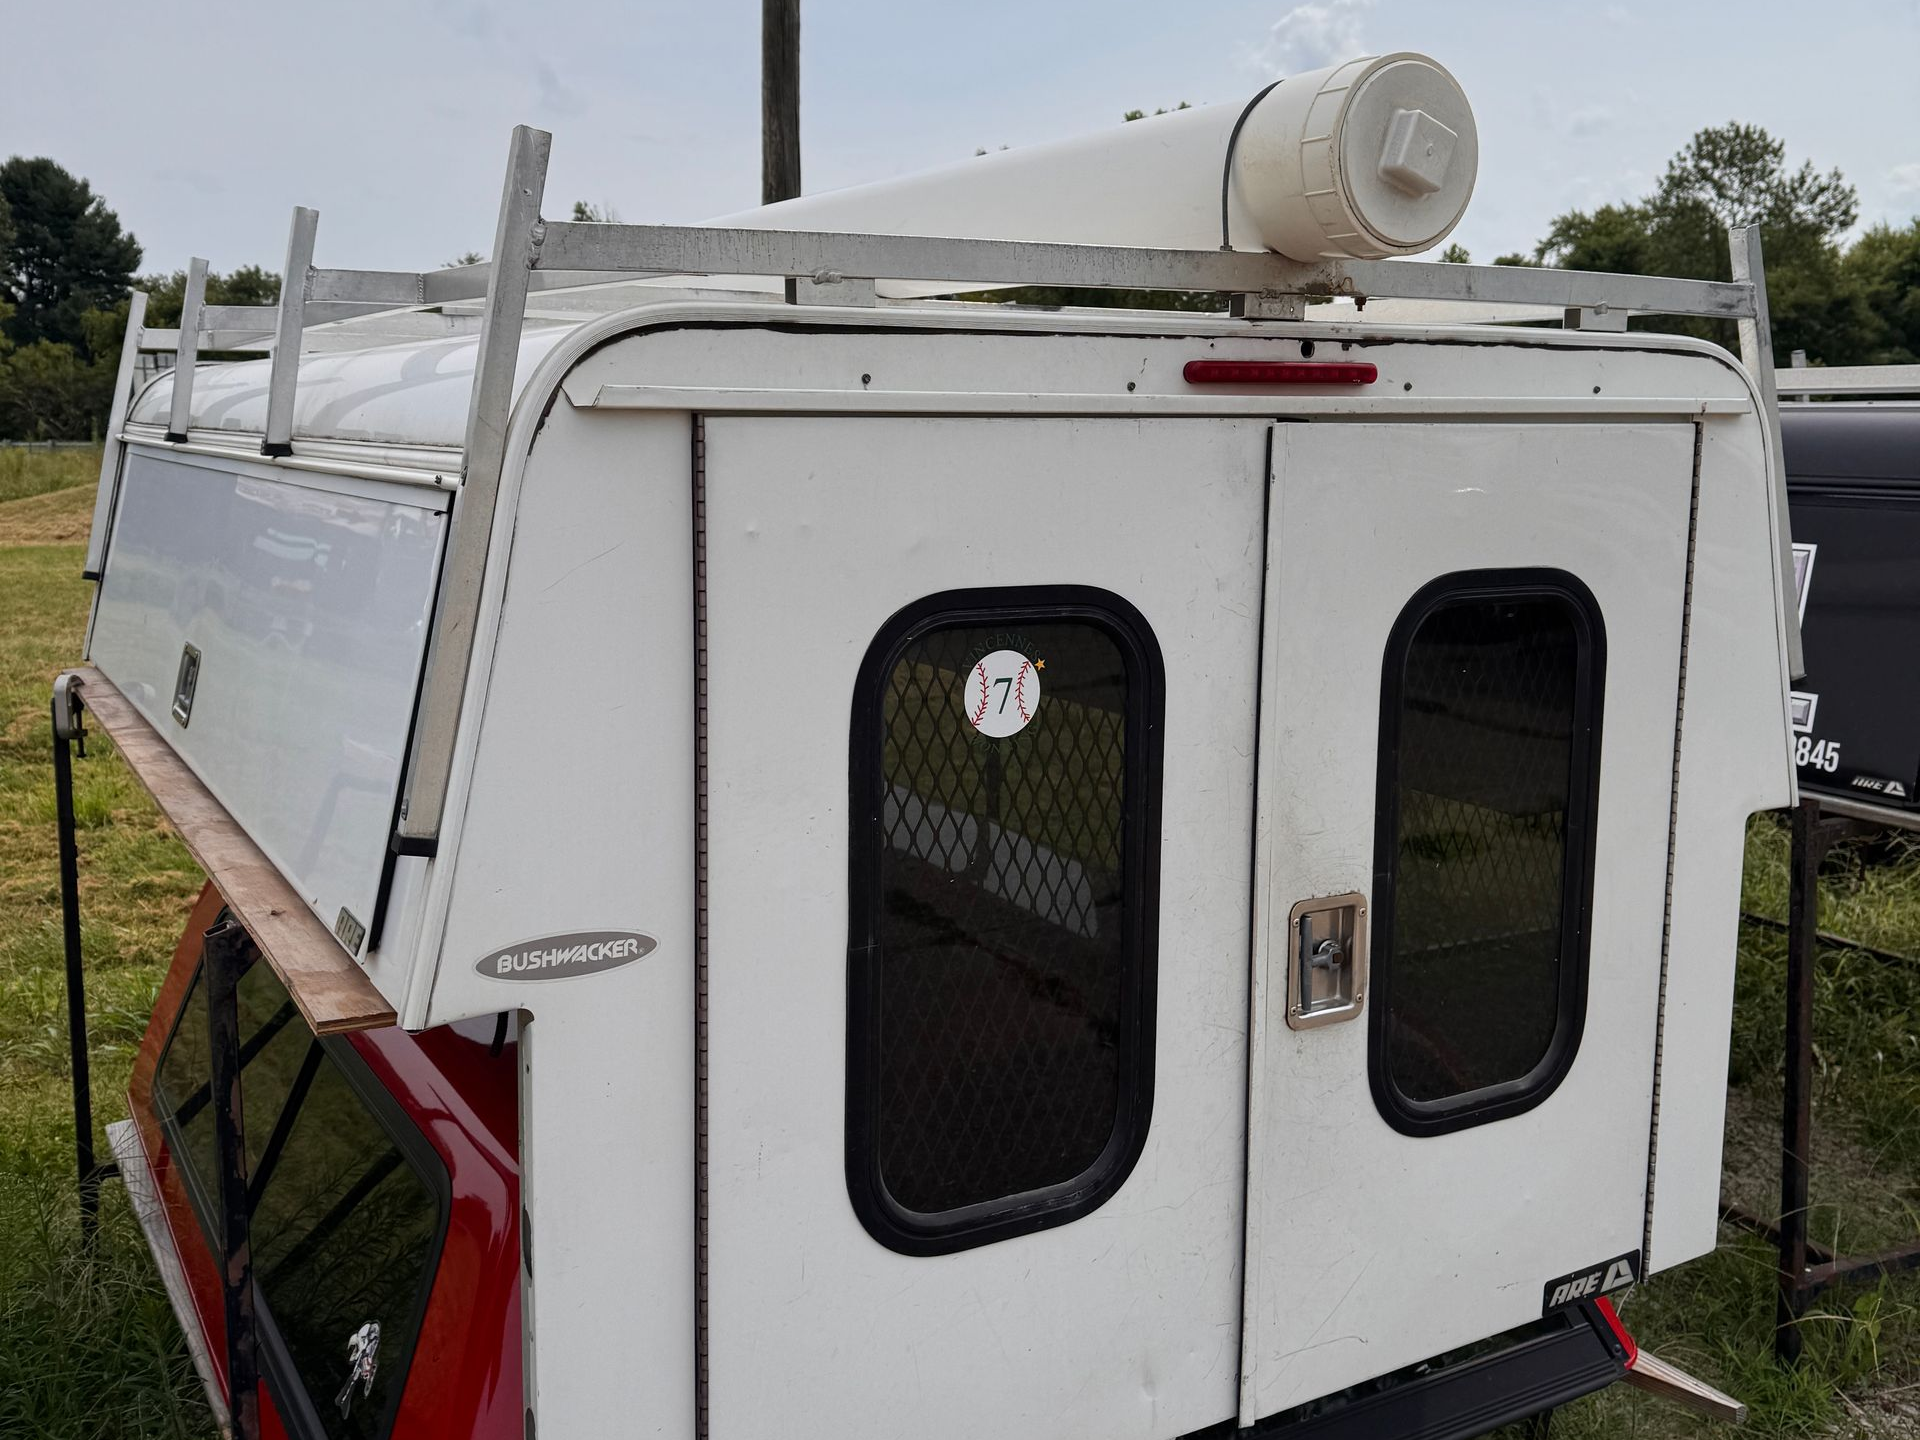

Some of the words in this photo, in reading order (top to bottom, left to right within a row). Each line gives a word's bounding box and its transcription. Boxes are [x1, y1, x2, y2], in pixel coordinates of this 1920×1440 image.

[993, 677, 1013, 714] 7
[1793, 735, 1841, 773] 845
[497, 938, 638, 974] BUSHWACKER
[1549, 1271, 1603, 1308] ARE
